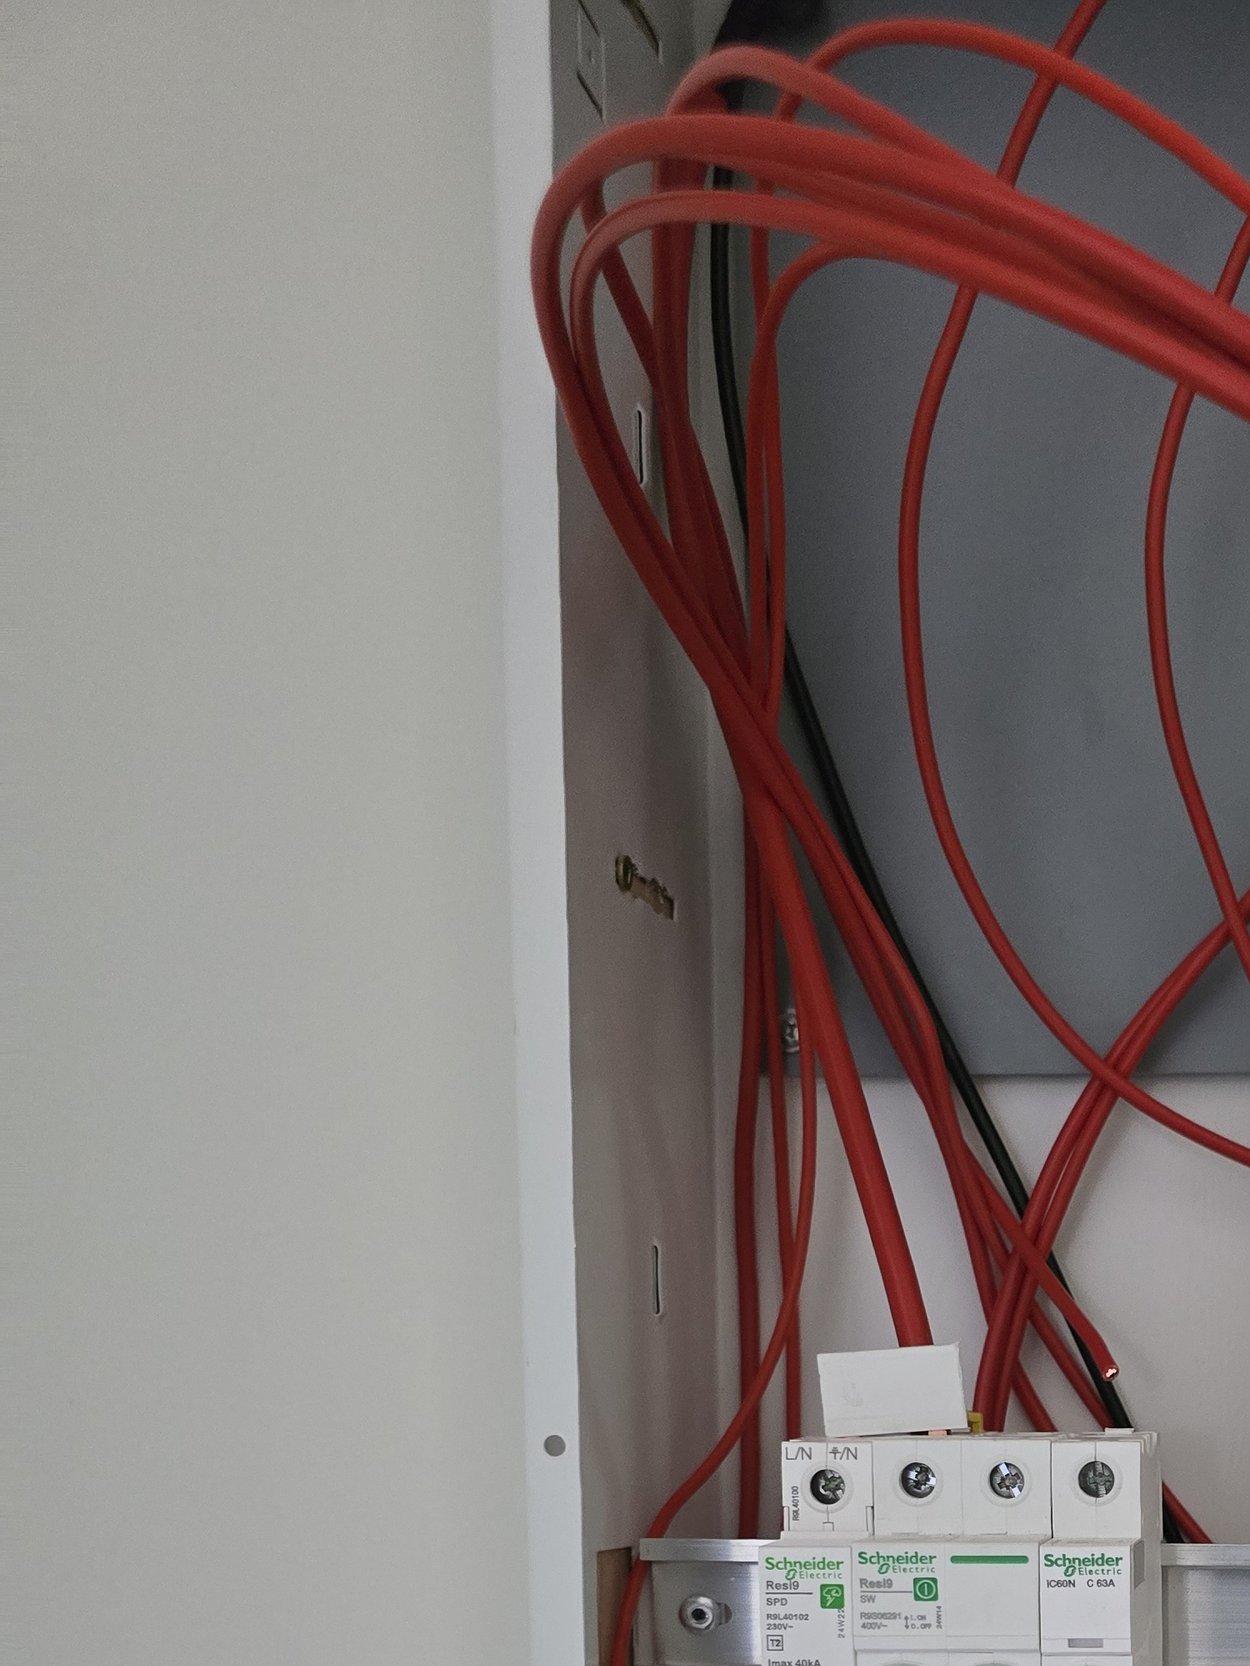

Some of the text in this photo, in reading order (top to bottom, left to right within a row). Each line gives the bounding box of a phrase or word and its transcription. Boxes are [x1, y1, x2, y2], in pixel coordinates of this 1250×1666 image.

[858, 1552, 936, 1566] Schneider
[1044, 1553, 1123, 1567] Schneider
[765, 1557, 844, 1572] Schneider
[1078, 1568, 1122, 1576] Electric
[1097, 1579, 1115, 1588] 63A
[766, 1598, 788, 1606] SPD
[770, 1639, 781, 1647] T2
